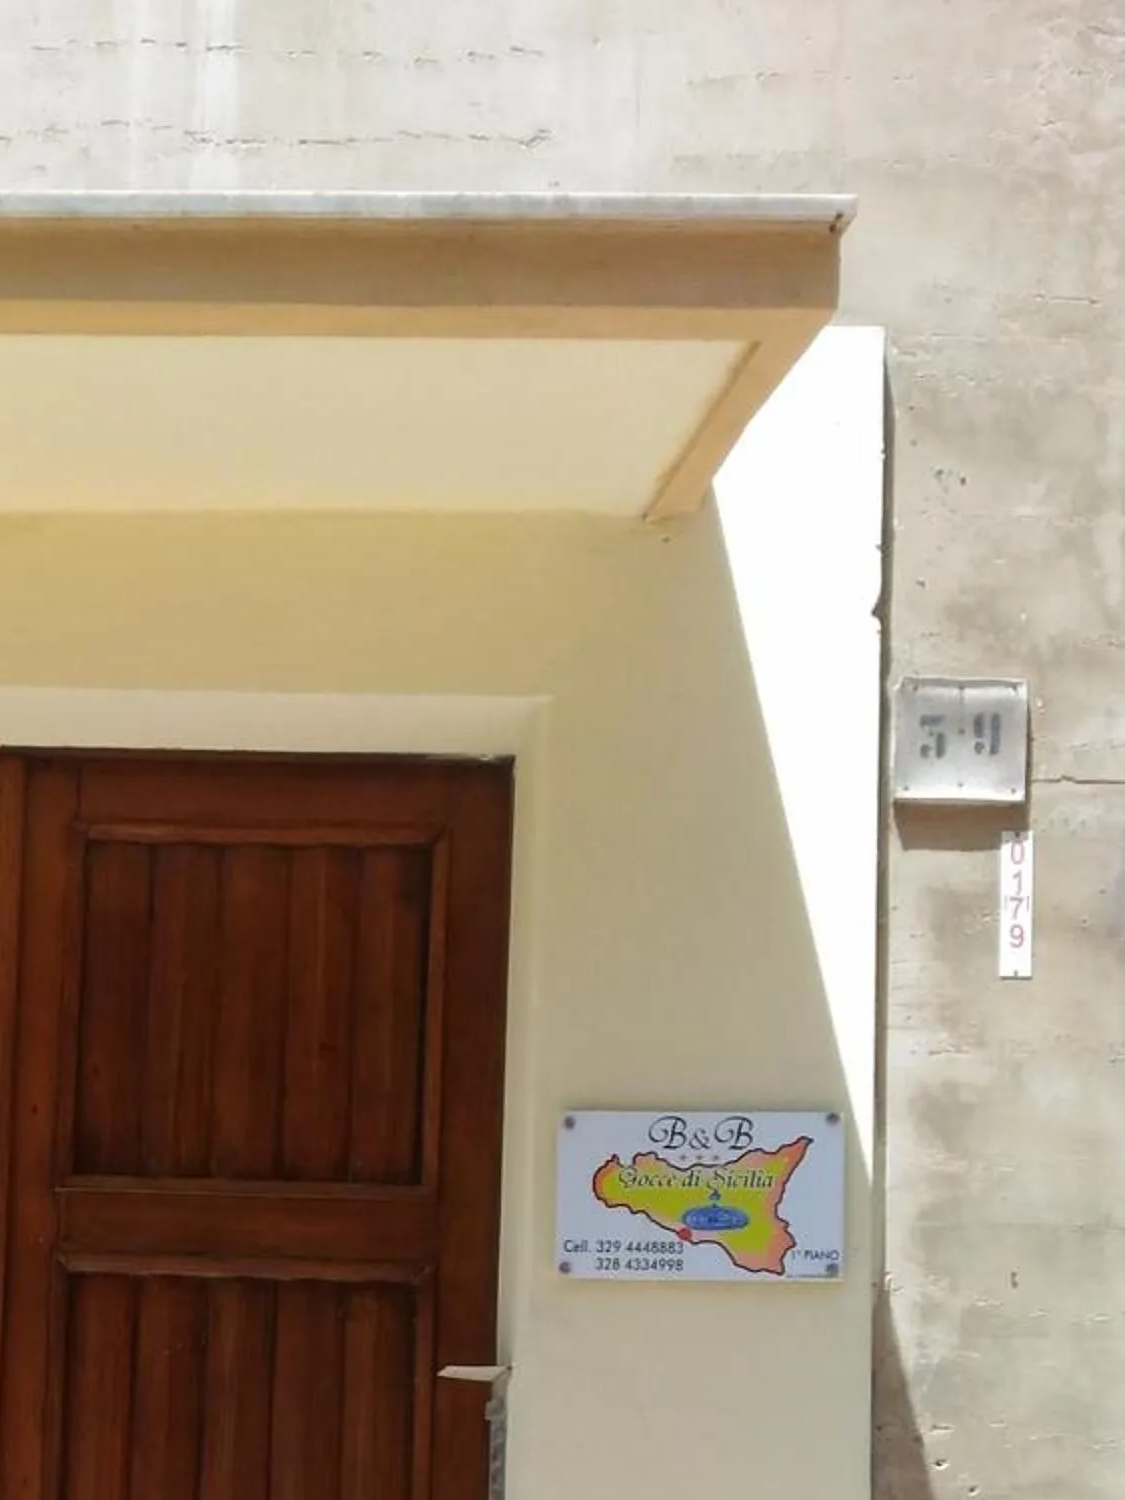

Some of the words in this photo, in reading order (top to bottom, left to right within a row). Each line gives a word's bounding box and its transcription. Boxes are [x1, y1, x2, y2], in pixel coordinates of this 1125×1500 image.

[648, 1115, 755, 1150] B&B
[681, 1168, 701, 1189] di
[705, 1167, 775, 1189] Sicilia
[595, 1239, 622, 1254] 329
[804, 1249, 840, 1261] PIANO
[594, 1256, 621, 1271] 328
[625, 1257, 684, 1272] 4334998
